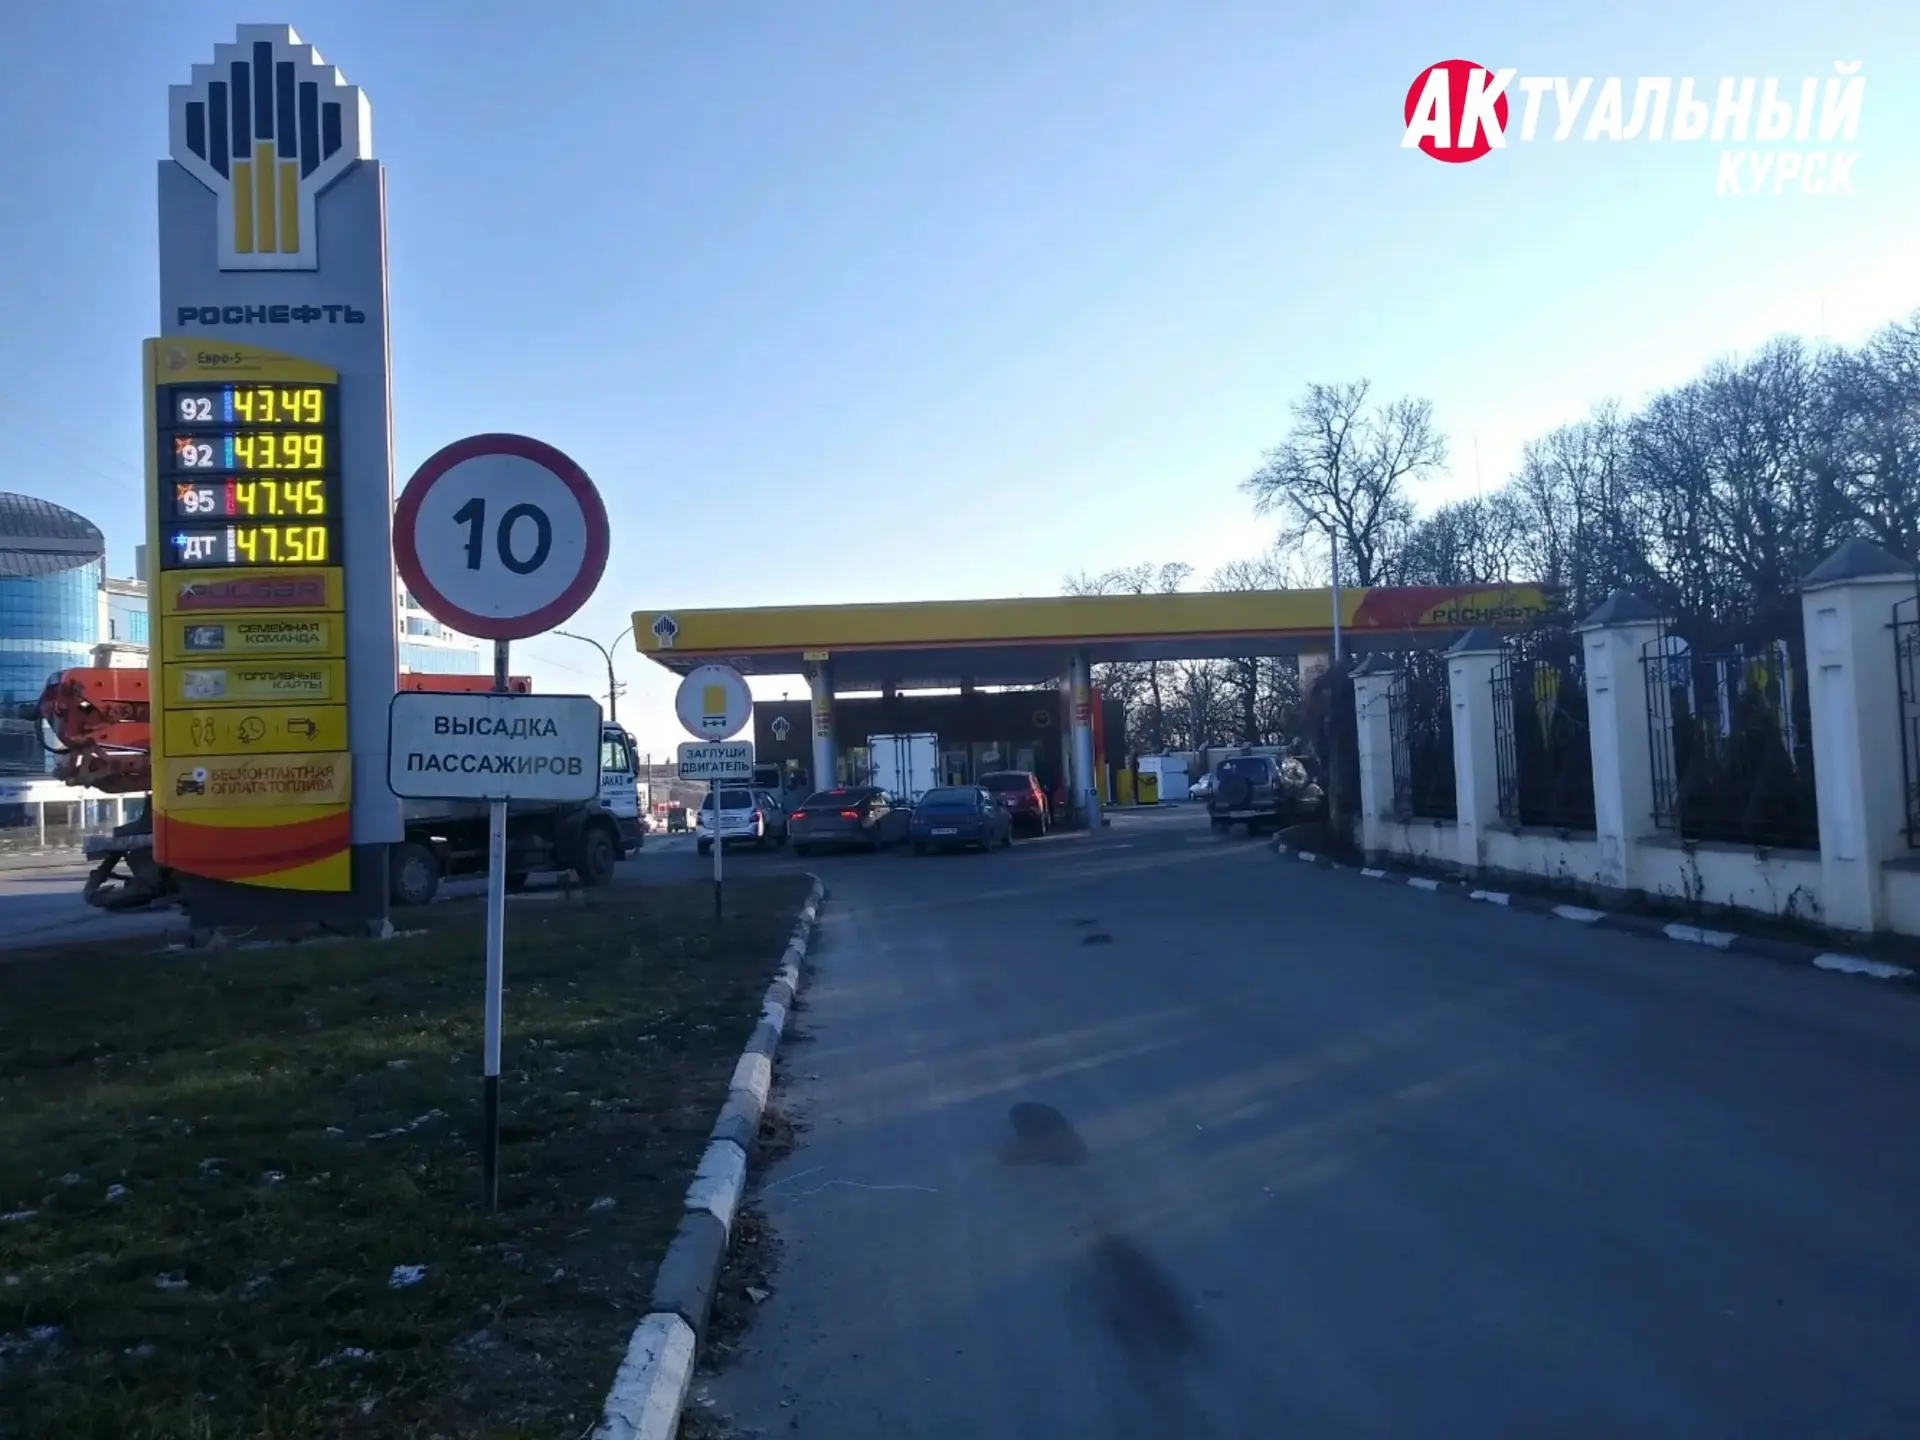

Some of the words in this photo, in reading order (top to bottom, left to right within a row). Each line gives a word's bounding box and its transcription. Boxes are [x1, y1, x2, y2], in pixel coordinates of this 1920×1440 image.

[178, 305, 365, 326] РОСНЕФТЬ
[181, 398, 213, 421] 92
[234, 388, 323, 423] 43.49
[182, 444, 214, 468] 92
[234, 434, 324, 469] 43.99
[183, 490, 215, 513] 95
[236, 480, 325, 515] 47.45
[184, 536, 217, 559] ДТ
[236, 526, 327, 562] 47.50
[452, 498, 552, 575] 10
[237, 622, 320, 634] СЕМЕЙНАЯ
[245, 634, 320, 644] КОМАНДА
[236, 672, 322, 682] ТОПЛИВНЫЕ
[272, 681, 323, 690] КАРТЫ
[434, 716, 558, 740] ВЫСАДКА
[686, 747, 746, 760] ЗАГЛУШИ
[210, 765, 335, 782] БЕСКОНТАКТНАЯ
[406, 753, 583, 777] ПАССАЖИРОВ
[681, 761, 750, 774] ДВИГАТЕЛЬ
[210, 780, 265, 796] ОПЛАТА
[268, 778, 335, 794] ТОПЛИВА
